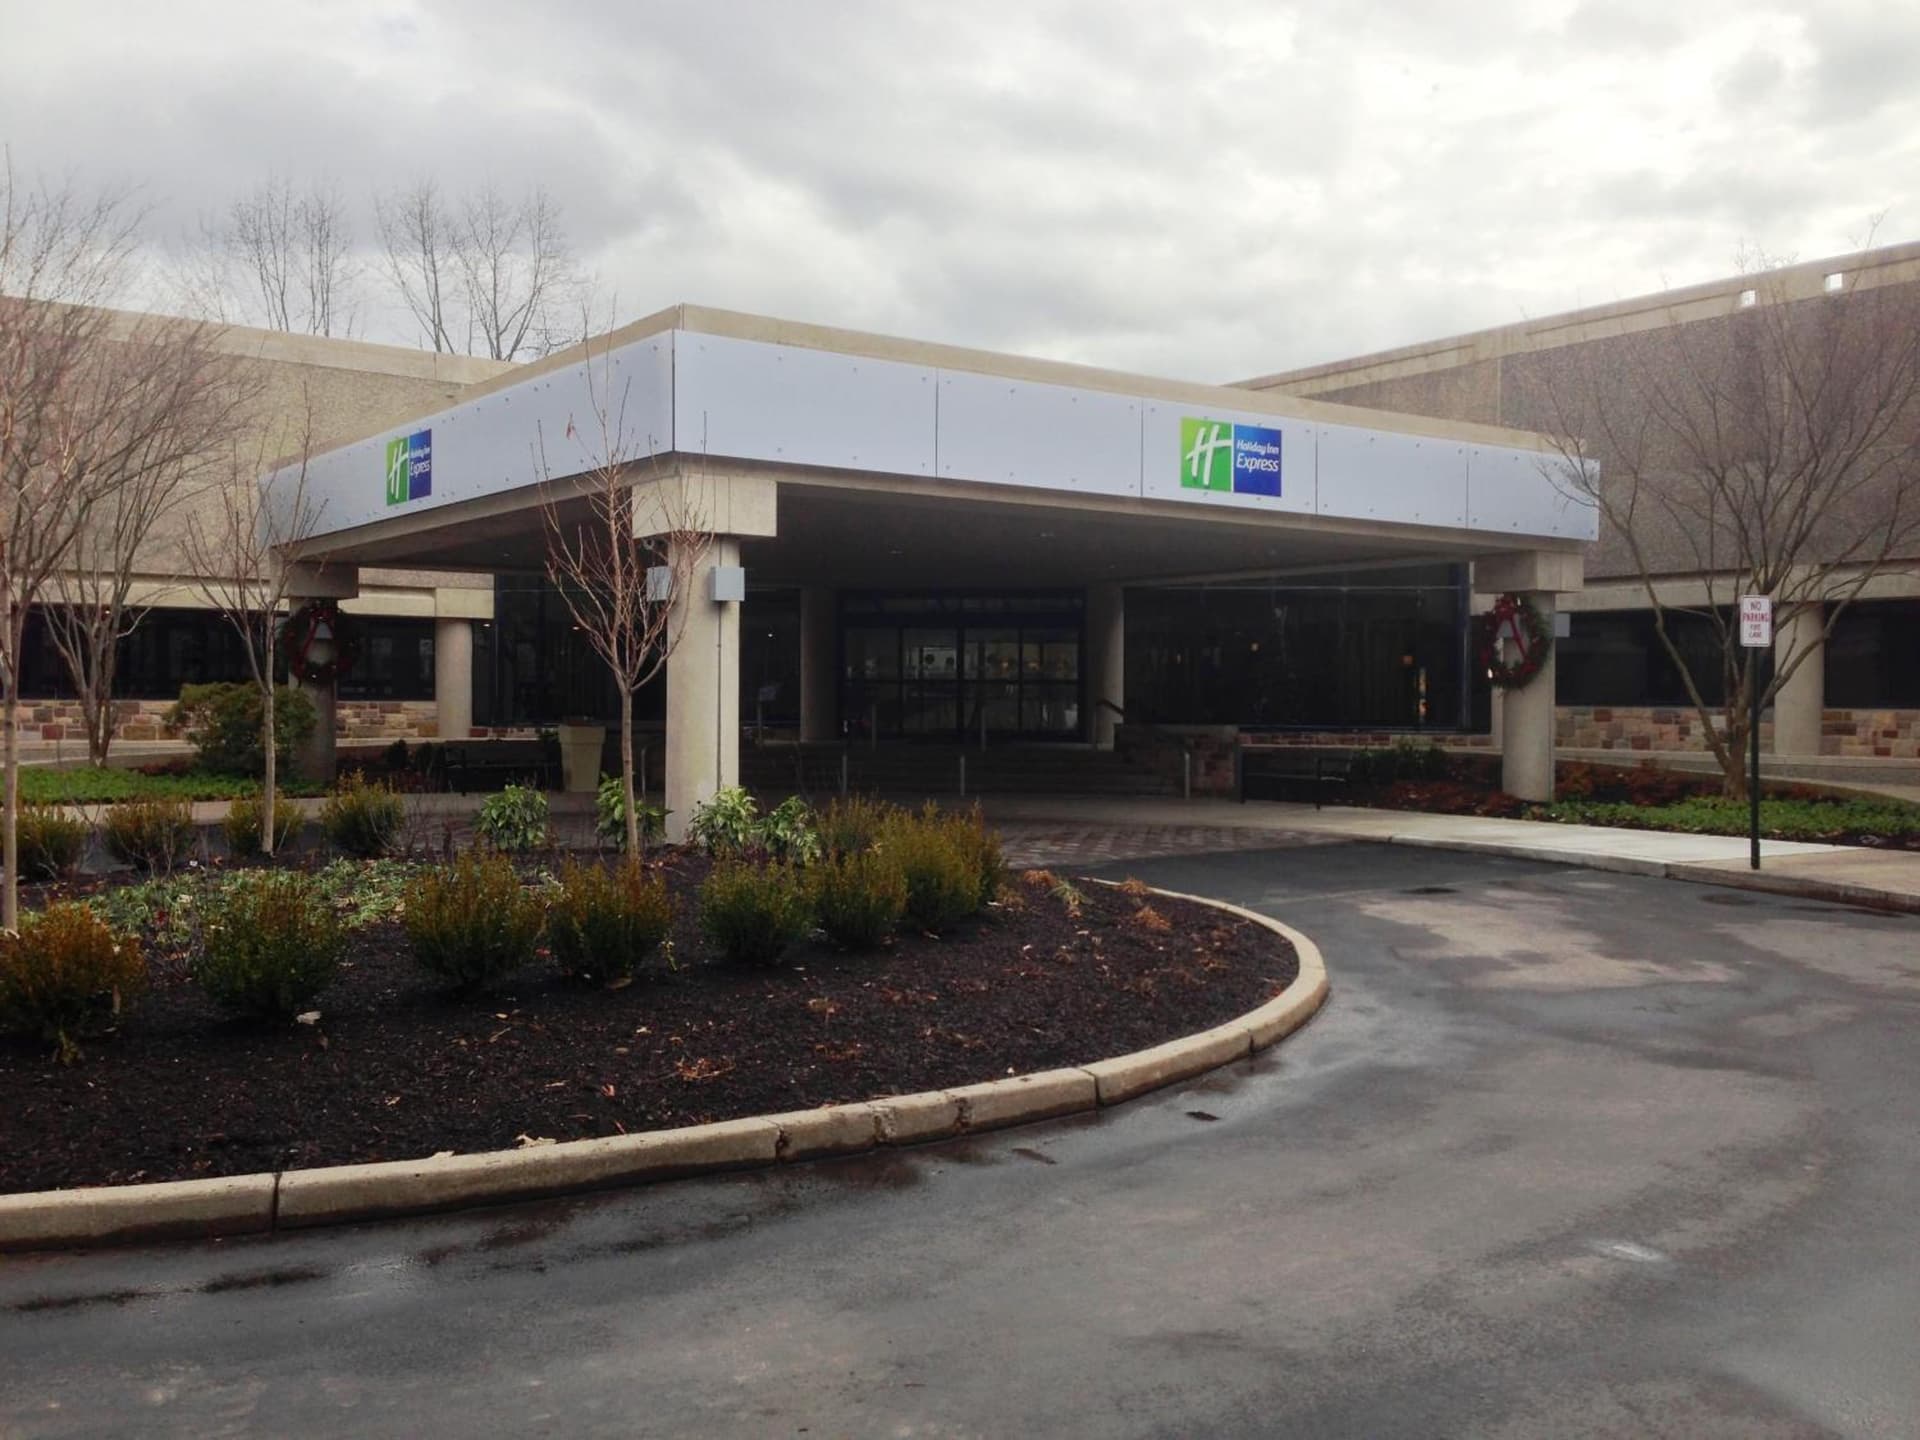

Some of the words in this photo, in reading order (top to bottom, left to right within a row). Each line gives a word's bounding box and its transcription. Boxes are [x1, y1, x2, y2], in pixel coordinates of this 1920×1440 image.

[1237, 440, 1266, 455] Holiday
[1266, 443, 1280, 454] Inn
[1236, 452, 1279, 473] Express
[1750, 601, 1761, 611] NO
[1743, 612, 1770, 622] PARKING
